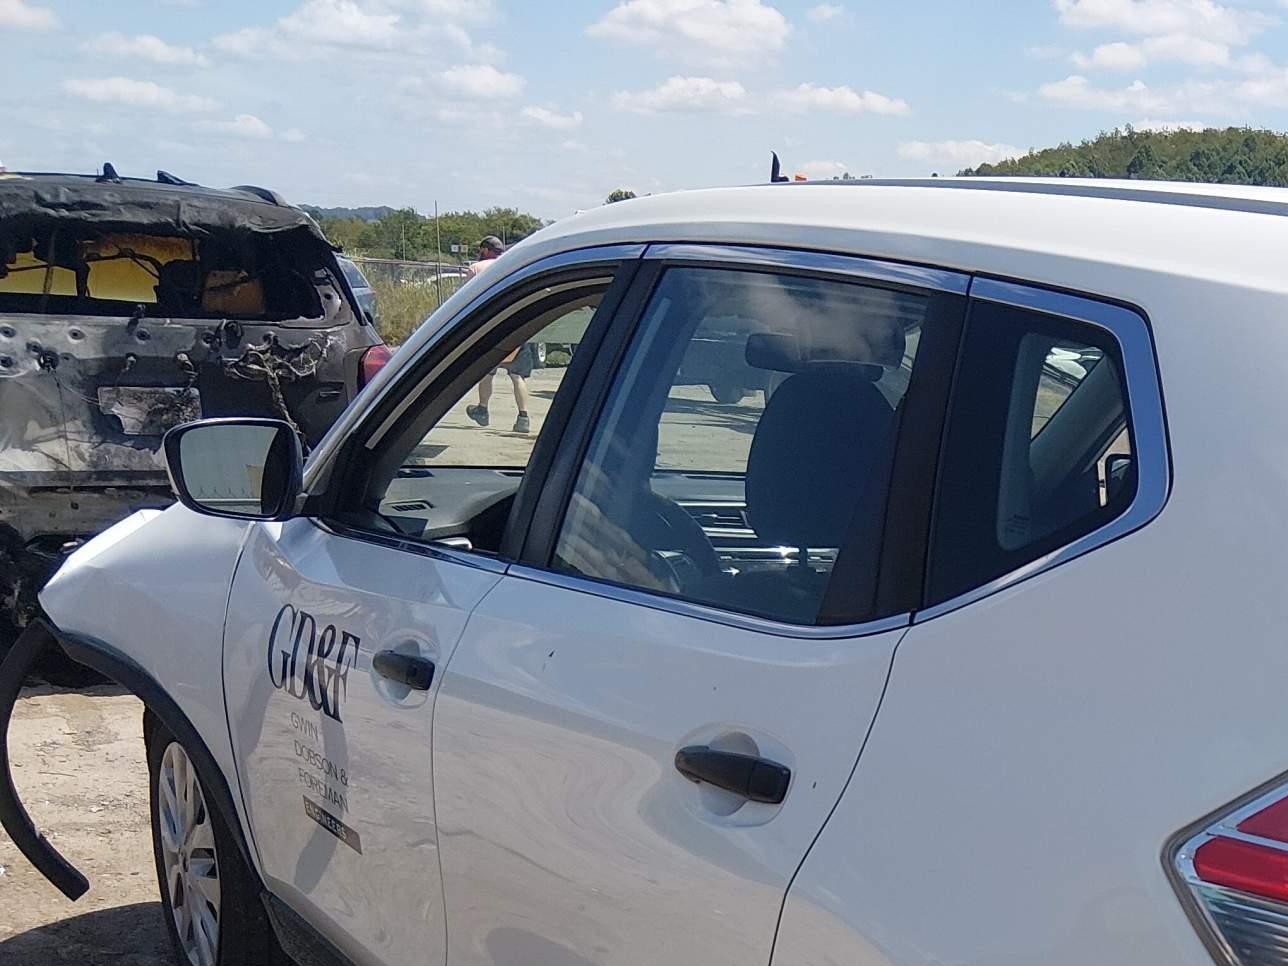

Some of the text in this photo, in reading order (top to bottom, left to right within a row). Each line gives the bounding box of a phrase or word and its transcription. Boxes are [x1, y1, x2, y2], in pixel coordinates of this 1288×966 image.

[267, 603, 361, 724] GD&F
[291, 711, 319, 741] GWIN
[294, 740, 349, 786] DOBSON &
[298, 767, 349, 814] FOREMAN
